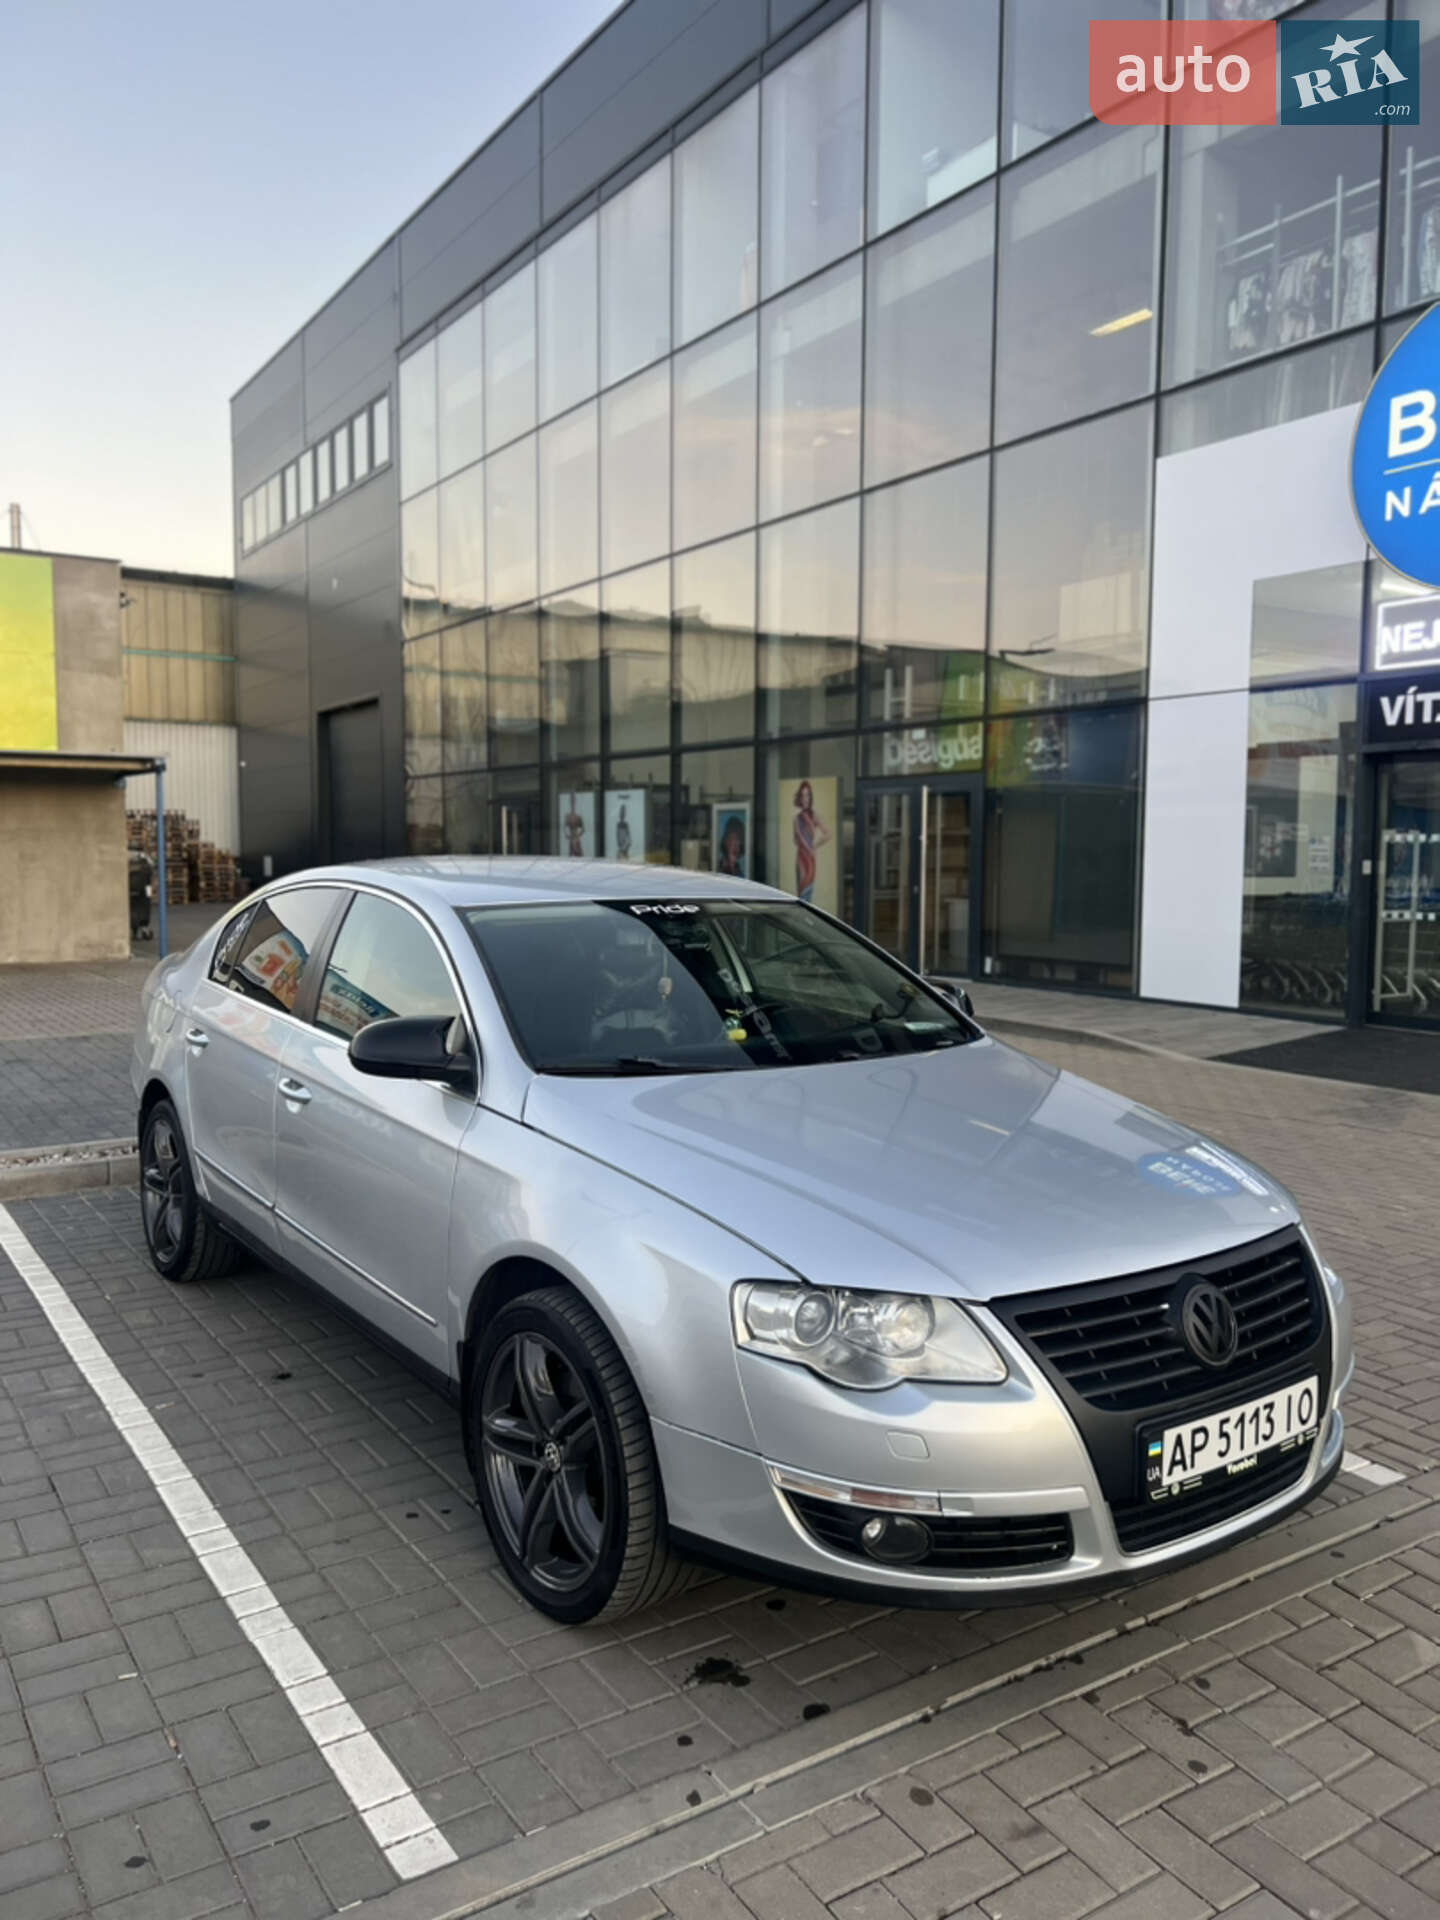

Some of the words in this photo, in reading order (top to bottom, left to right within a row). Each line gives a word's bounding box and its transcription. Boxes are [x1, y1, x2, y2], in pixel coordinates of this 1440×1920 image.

[1380, 686, 1440, 726] VÍT
[1167, 1426, 1209, 1477] AP
[1217, 1401, 1275, 1458] 5113
[1286, 1387, 1313, 1433] IO
